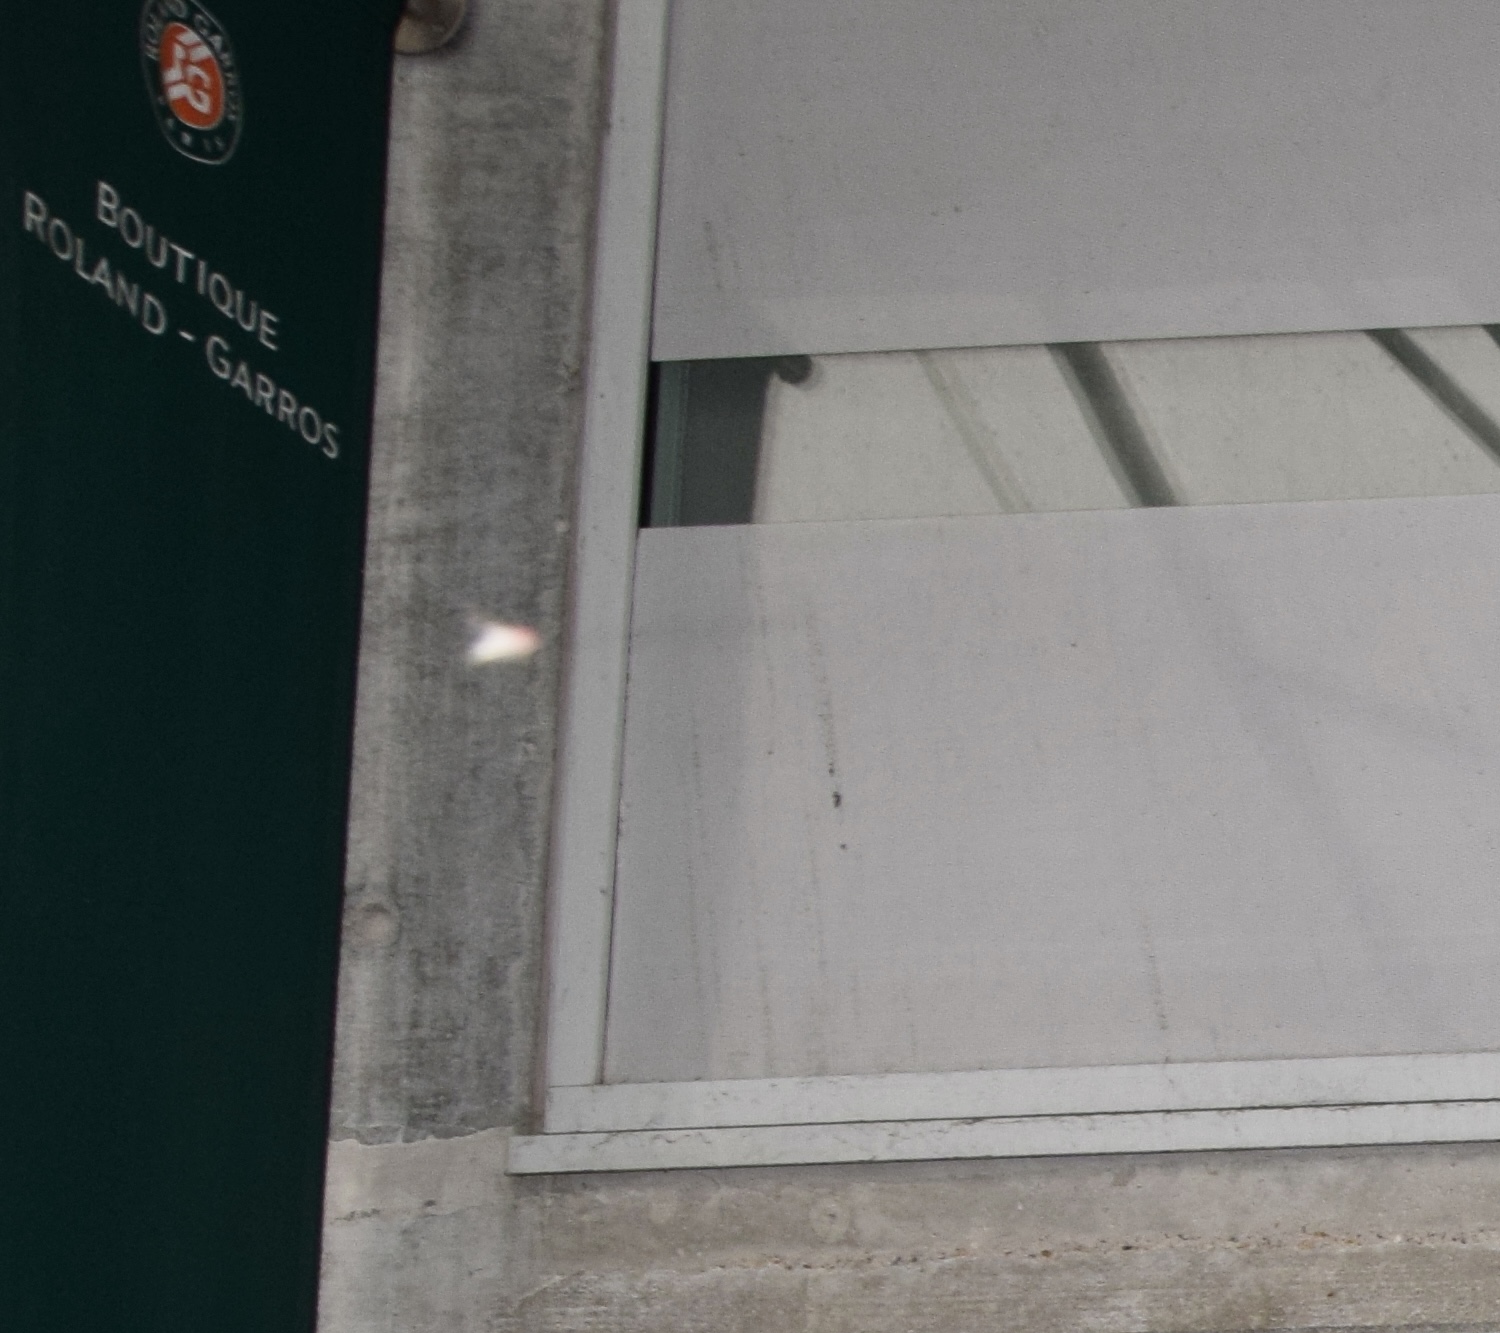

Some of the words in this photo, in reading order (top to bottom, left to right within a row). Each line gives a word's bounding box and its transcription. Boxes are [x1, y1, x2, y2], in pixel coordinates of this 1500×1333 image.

[22, 190, 168, 336] ROLAND
[205, 334, 340, 459] GARROS
[95, 180, 281, 352] BOUTIQUE
